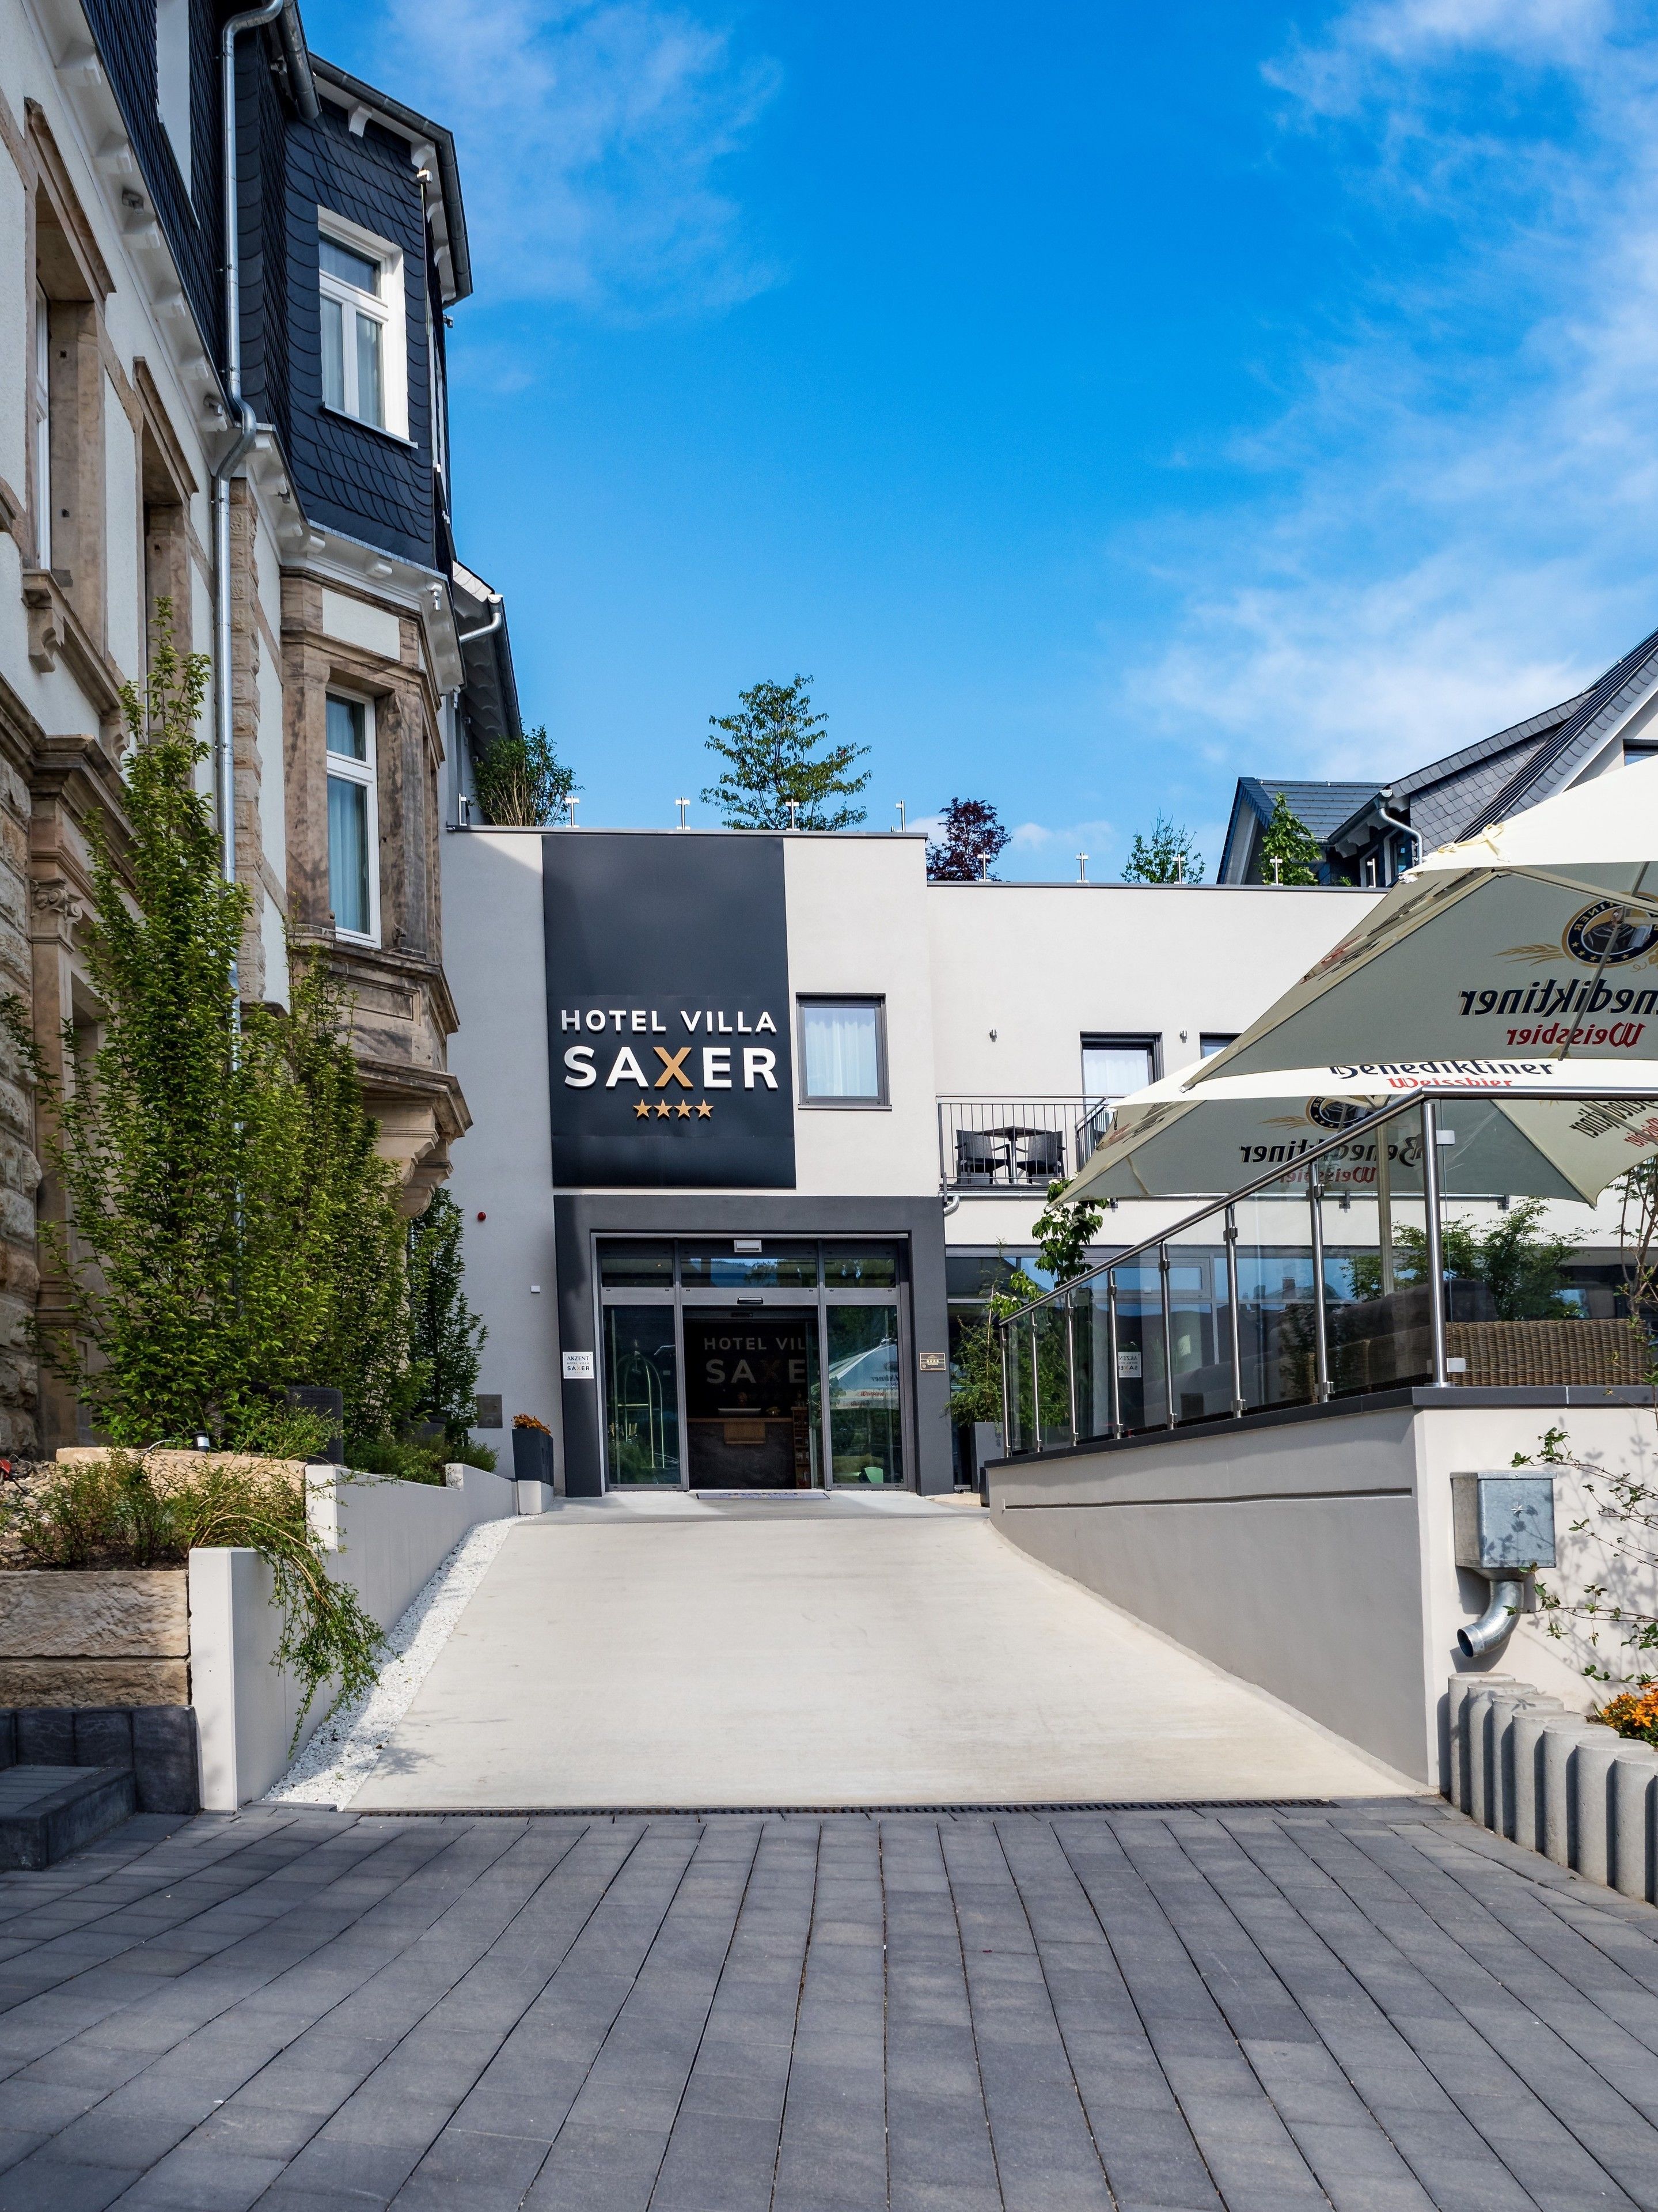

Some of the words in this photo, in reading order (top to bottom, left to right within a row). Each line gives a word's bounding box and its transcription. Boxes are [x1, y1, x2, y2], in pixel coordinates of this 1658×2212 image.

[561, 1009, 666, 1032] HOTEL
[680, 1010, 777, 1033] VILLA
[563, 1046, 779, 1089] SAXER
[704, 1337, 767, 1350] HOTEL
[775, 1337, 806, 1350] VIL
